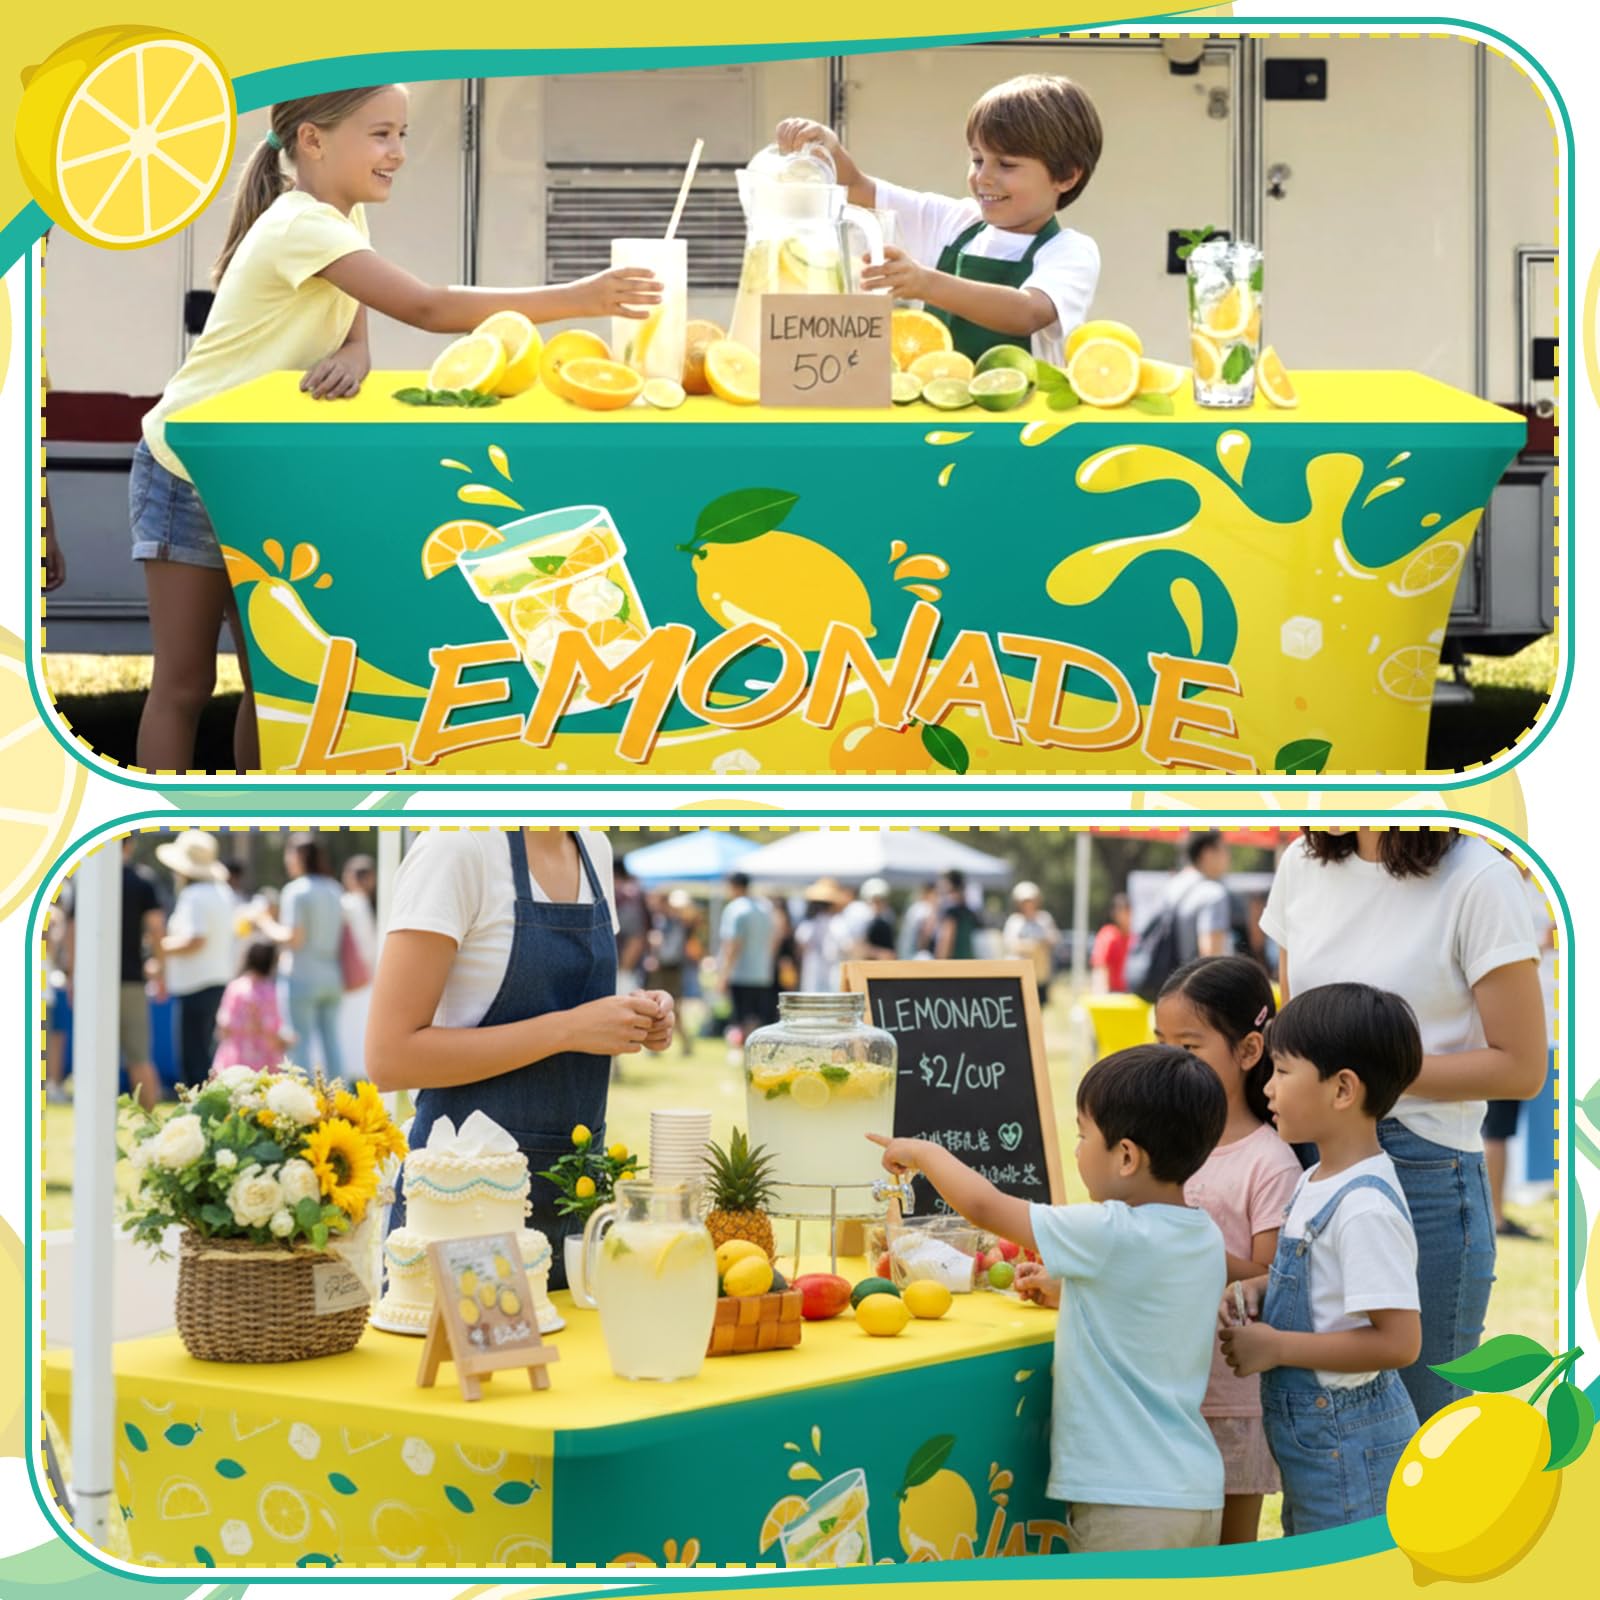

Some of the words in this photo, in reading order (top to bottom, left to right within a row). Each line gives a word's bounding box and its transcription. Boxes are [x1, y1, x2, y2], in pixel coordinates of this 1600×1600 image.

[770, 312, 883, 340] LEMONADE
[280, 600, 1257, 774] LEMONADE
[878, 996, 1017, 1032] LEMONADE
